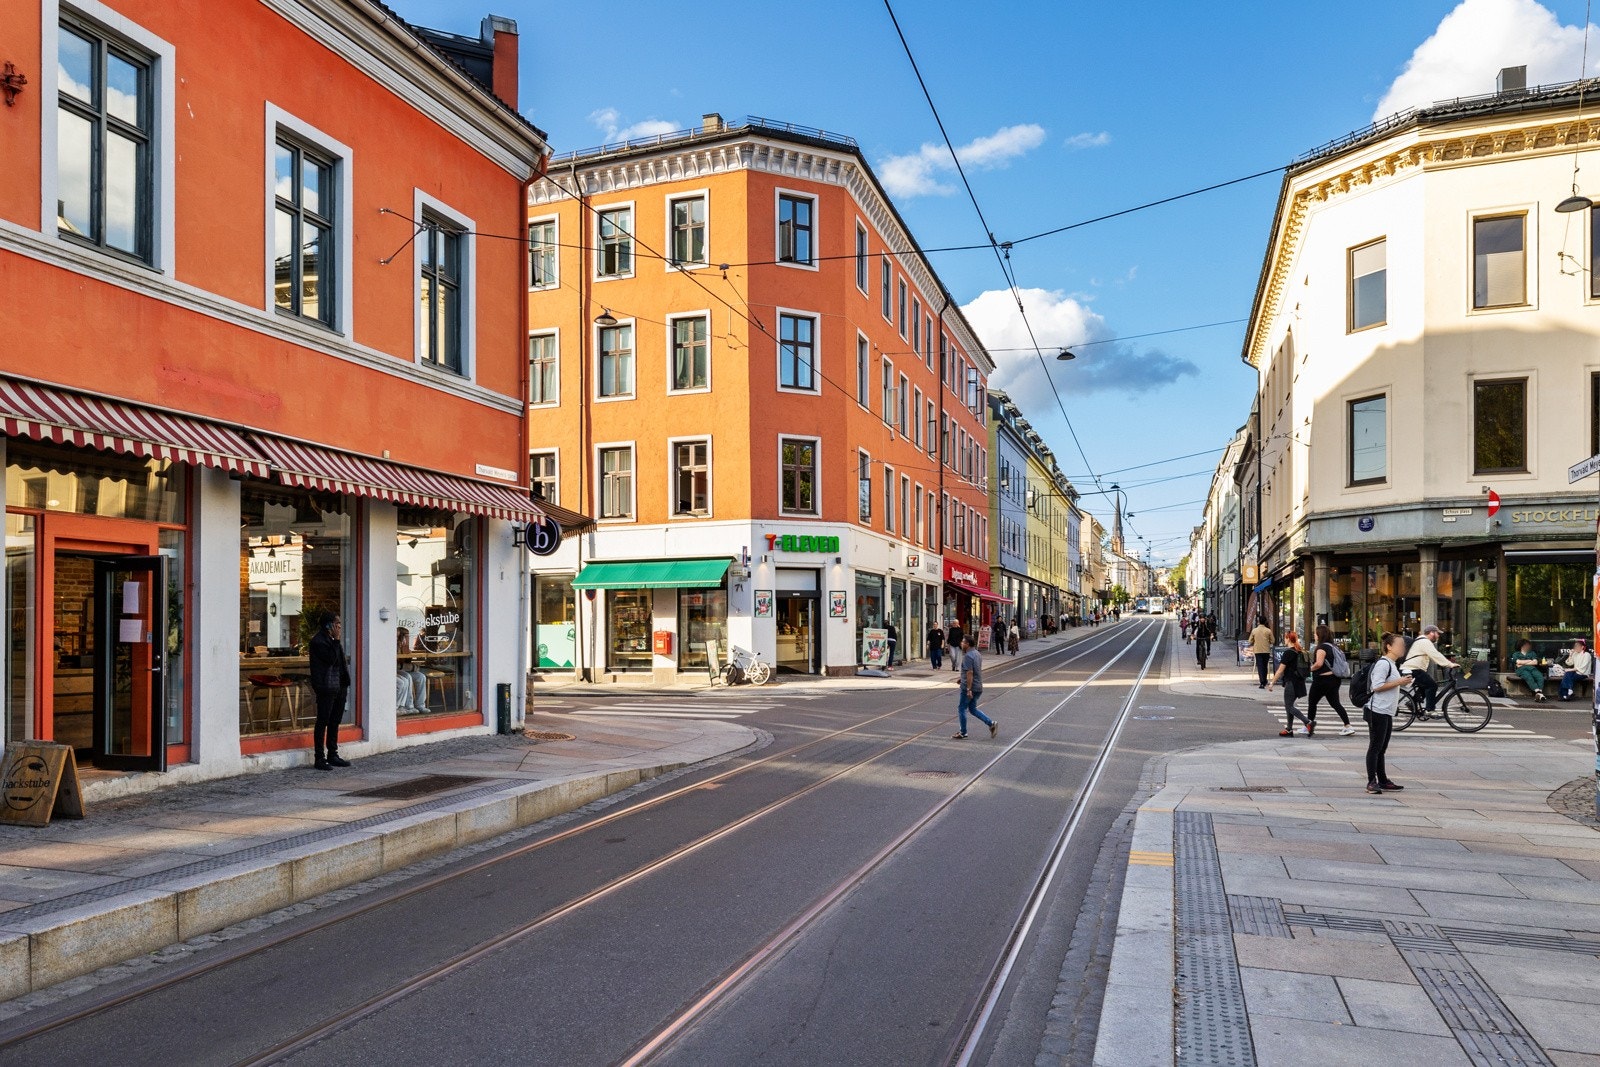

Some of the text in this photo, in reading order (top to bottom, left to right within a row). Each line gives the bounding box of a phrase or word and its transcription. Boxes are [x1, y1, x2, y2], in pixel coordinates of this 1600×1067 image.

[1571, 464, 1589, 479] Thorvald
[534, 522, 549, 549] b
[734, 584, 744, 592] 71
